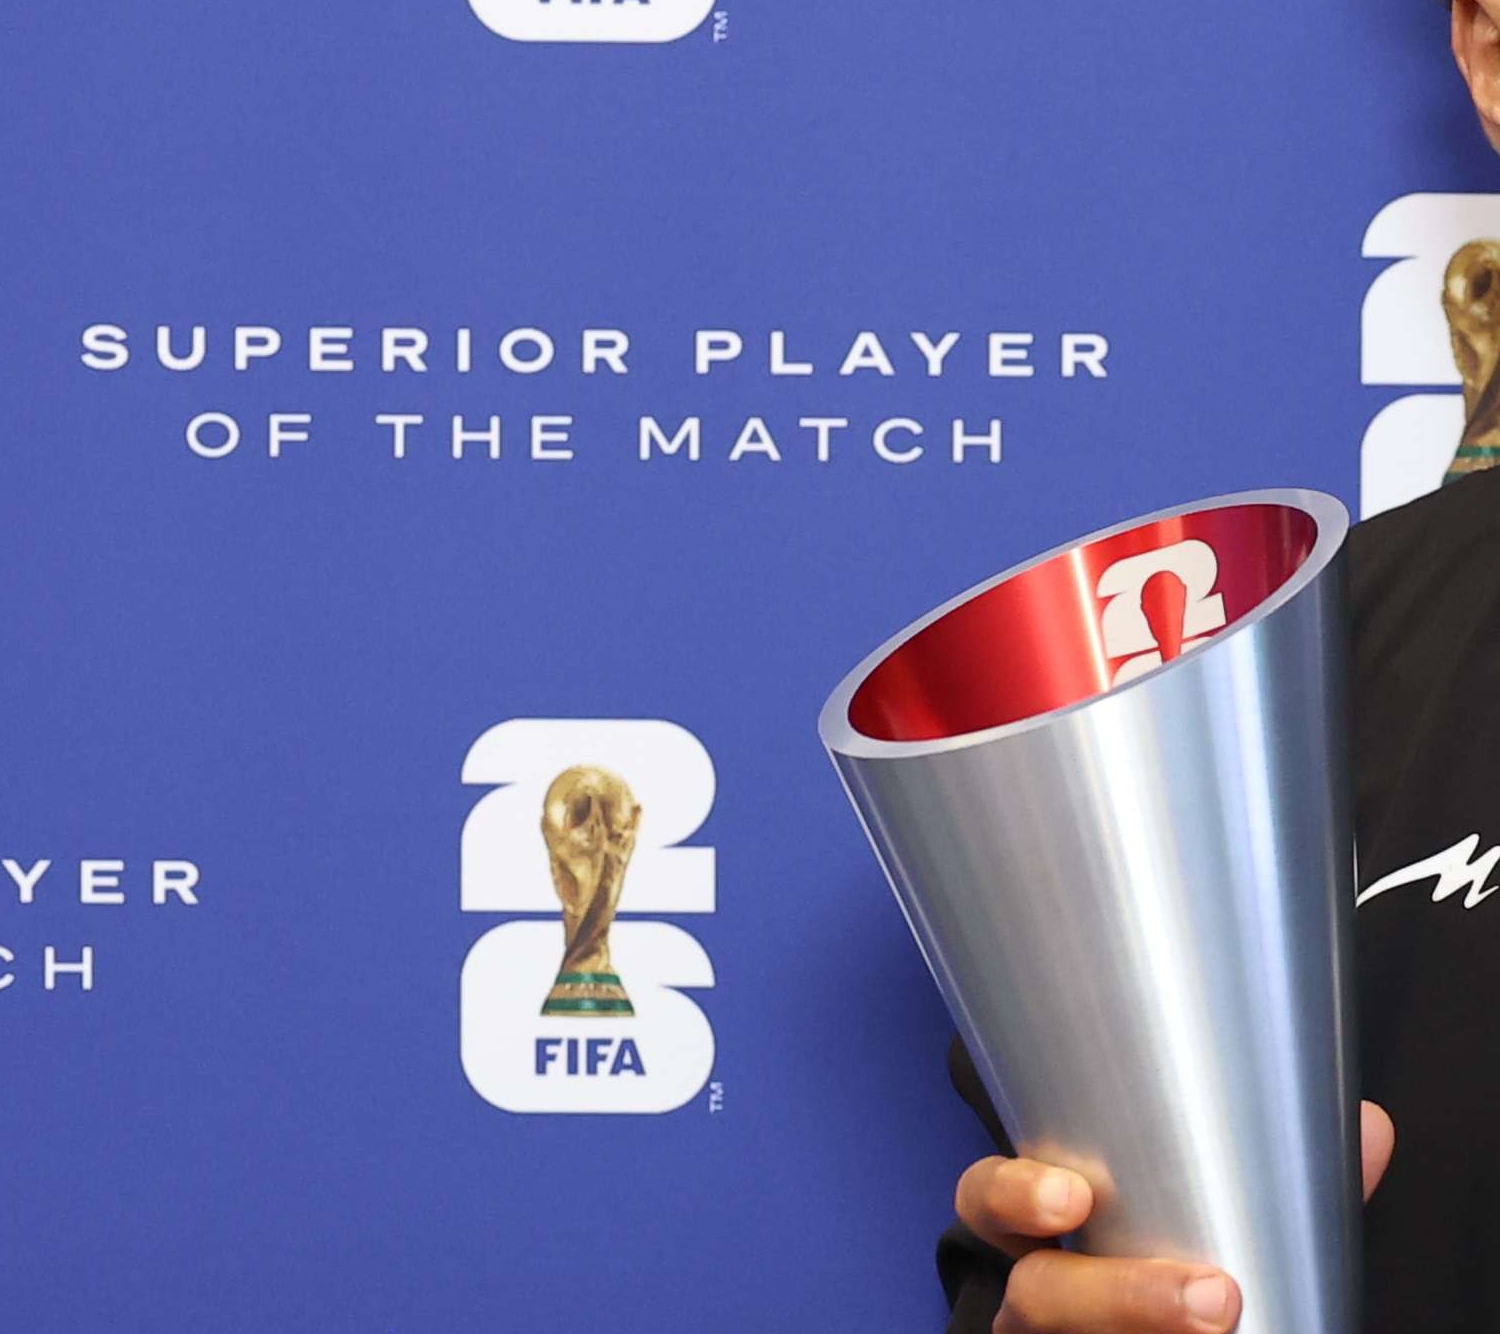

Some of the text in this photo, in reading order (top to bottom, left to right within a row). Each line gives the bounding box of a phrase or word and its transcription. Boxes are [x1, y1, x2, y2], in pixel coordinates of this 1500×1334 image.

[80, 324, 1109, 378] SUPERIOR PLAYER
[186, 412, 1002, 464] OF THE MATCH
[534, 1037, 647, 1076] FIFA
